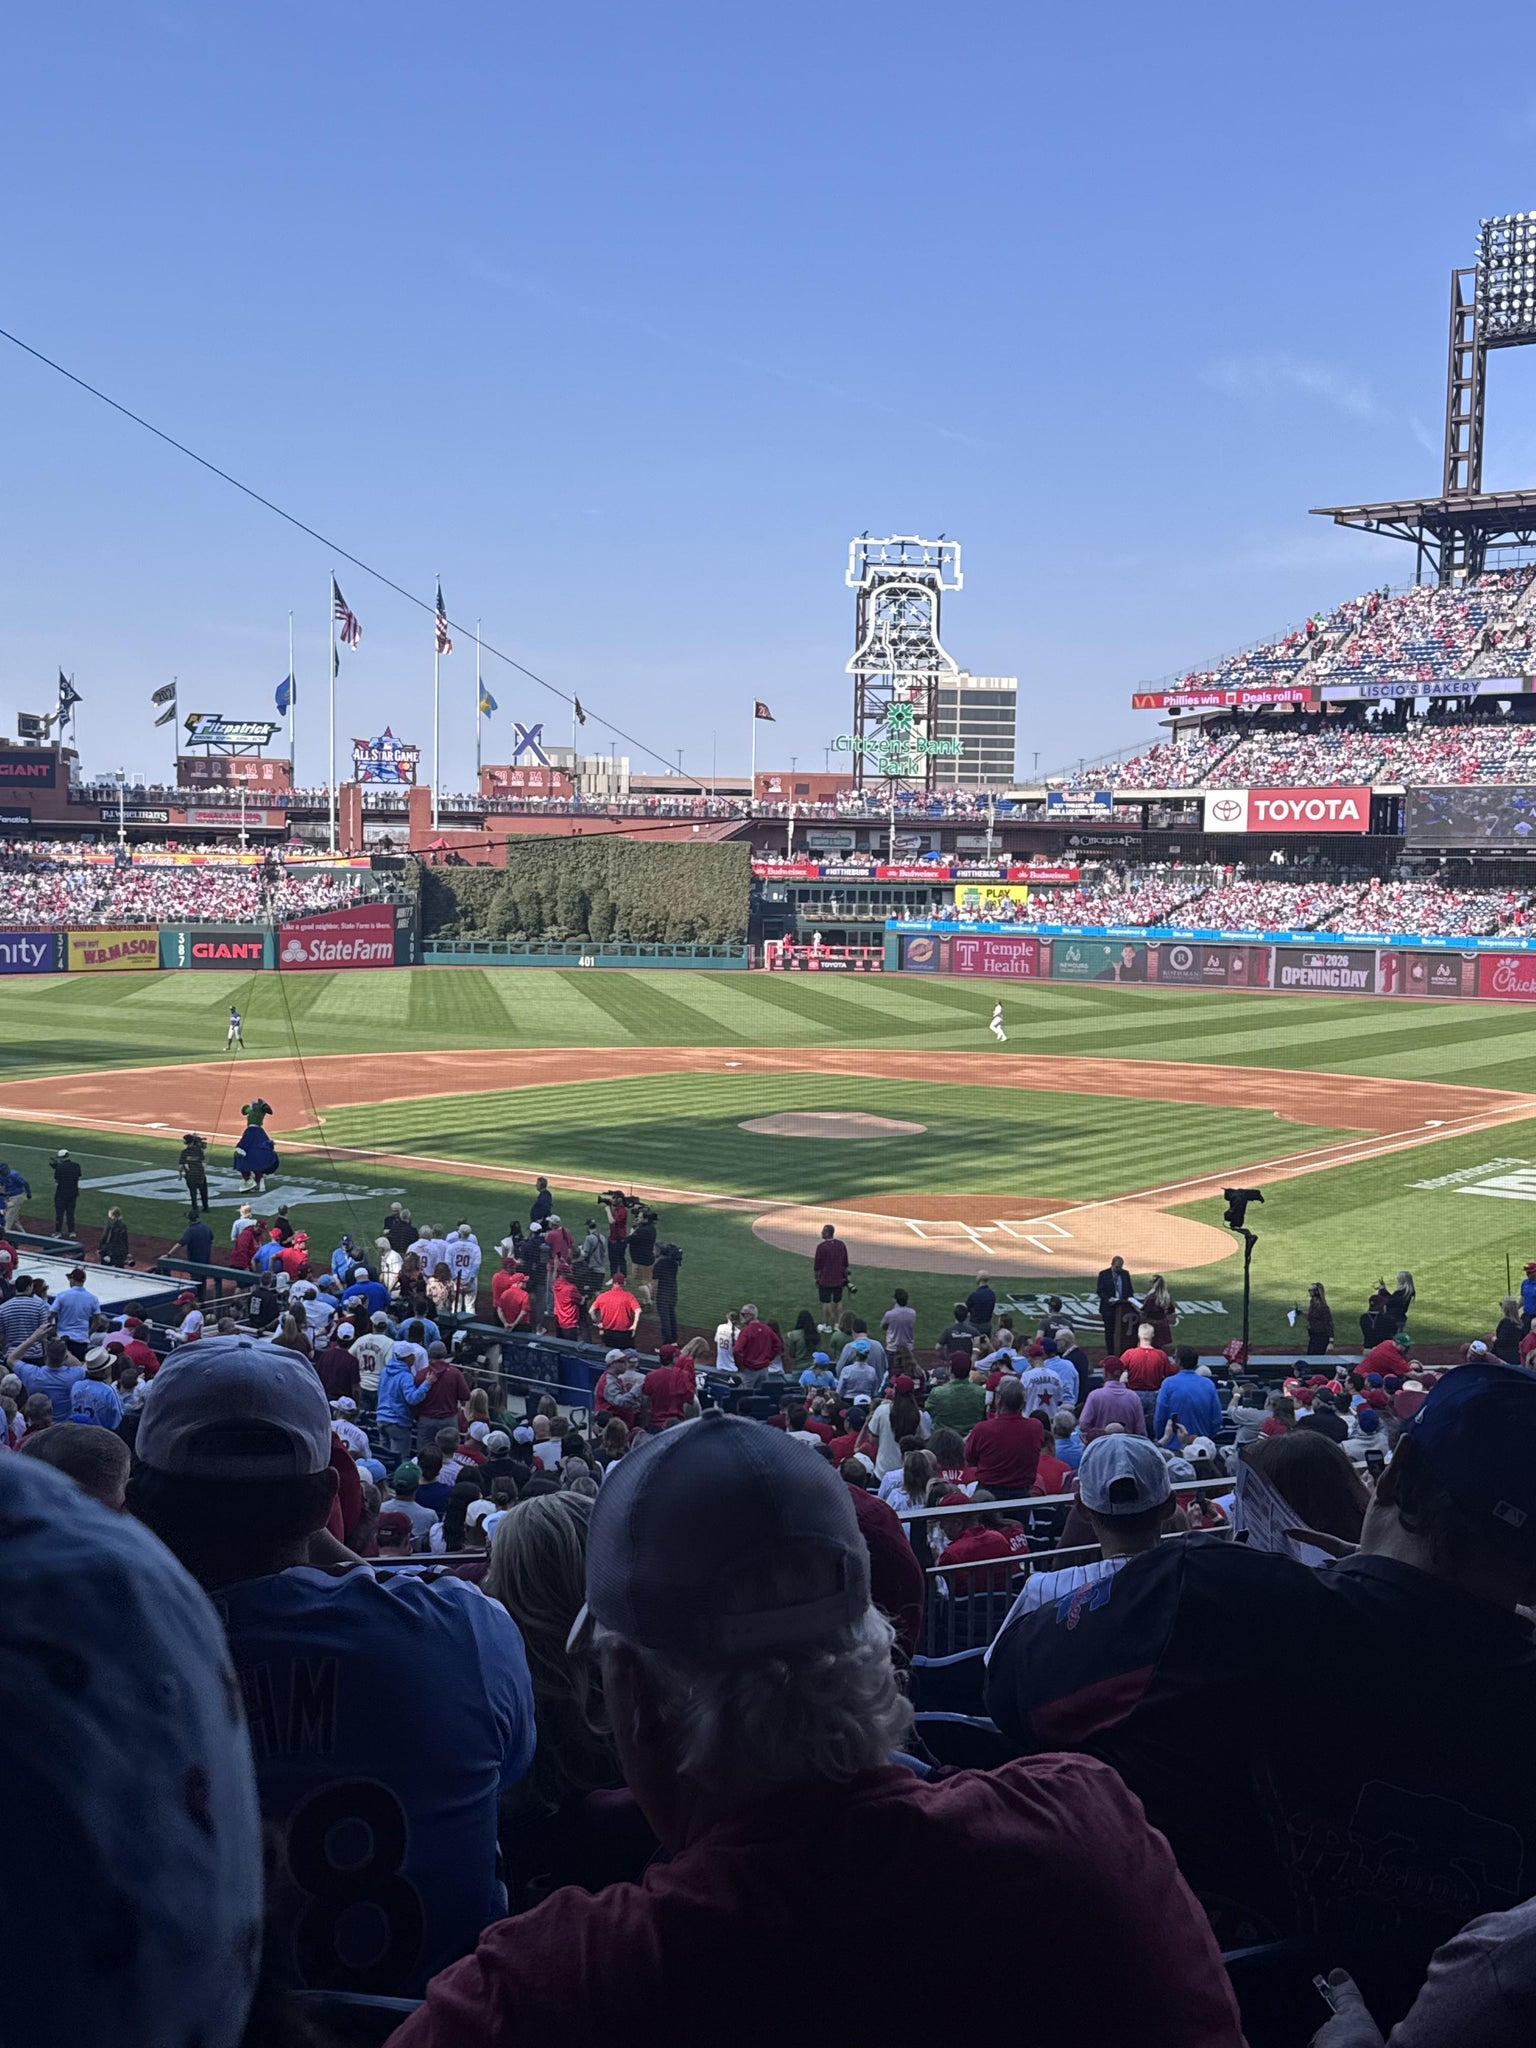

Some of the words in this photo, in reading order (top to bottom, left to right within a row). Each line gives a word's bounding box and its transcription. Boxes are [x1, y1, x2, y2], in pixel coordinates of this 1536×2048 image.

[1360, 685, 1418, 697] LISCIO'S
[1423, 681, 1480, 694] BAKERY
[1163, 696, 1199, 707] Phillies
[1200, 694, 1220, 704] win
[1242, 693, 1273, 703] Deals
[1273, 691, 1291, 702] roll
[1292, 691, 1303, 701] in
[196, 715, 272, 735] Fitzpatrick
[511, 722, 551, 767] X
[835, 735, 912, 754] Citizens
[916, 736, 964, 755] Bank
[353, 748, 371, 761] ALL
[394, 750, 419, 762] GAME
[0, 764, 50, 777] GIANT
[877, 757, 919, 776] Park
[1254, 799, 1360, 821] TOYOTA
[767, 867, 807, 876] Budweiser
[899, 868, 939, 878] Budweiser
[1030, 870, 1070, 879] Budweiser
[986, 889, 1010, 898] PLAY
[300, 923, 314, 931] good
[315, 923, 340, 931] neighbor,
[341, 922, 355, 930] State
[192, 943, 262, 959] GIANT
[983, 941, 1033, 959] Temple
[578, 956, 595, 967] 401
[1177, 953, 1186, 962] R
[1325, 955, 1349, 967] 2026
[983, 959, 1030, 974] Health
[1281, 966, 1340, 987] OPENING
[1340, 968, 1370, 988] DAY
[455, 1254, 470, 1267] 20
[719, 1337, 729, 1350] 26
[362, 1354, 375, 1372] 10
[942, 1469, 964, 1481] RUIZ
[285, 1775, 427, 1990] 8
